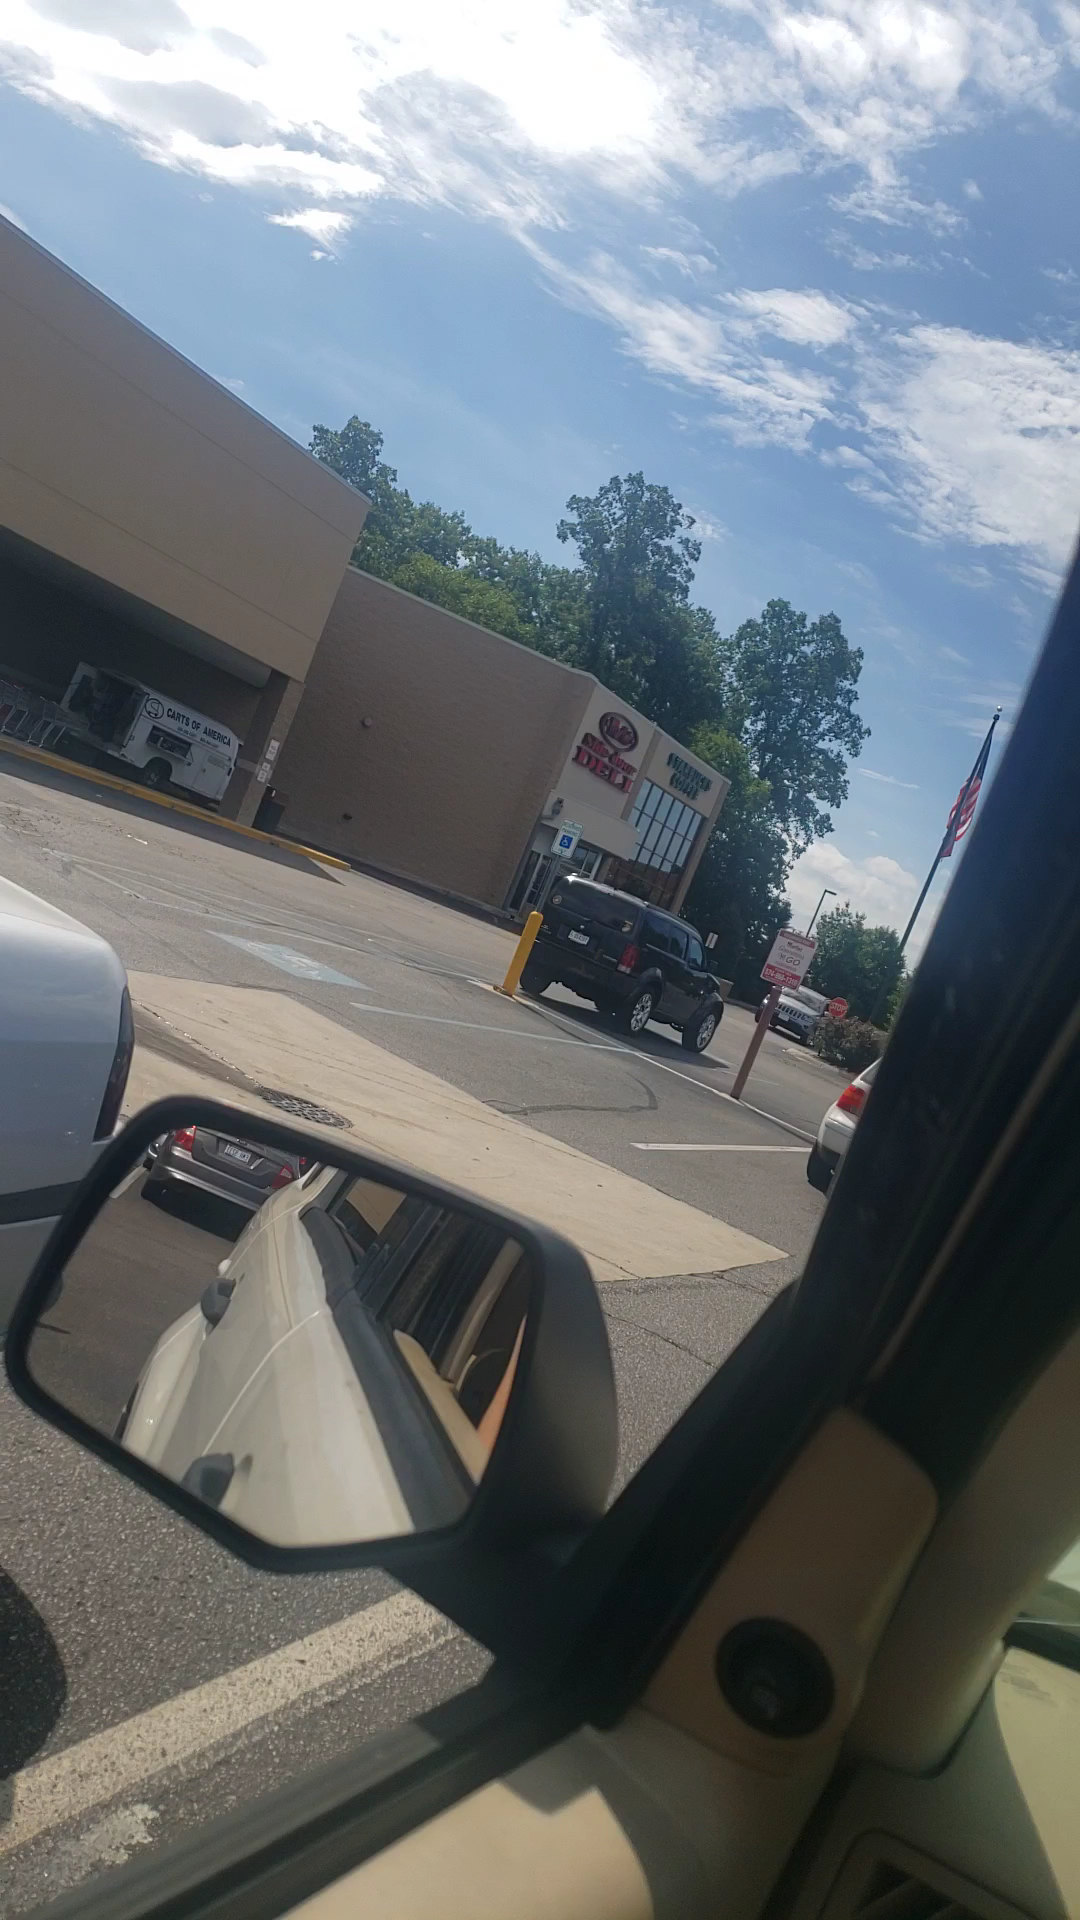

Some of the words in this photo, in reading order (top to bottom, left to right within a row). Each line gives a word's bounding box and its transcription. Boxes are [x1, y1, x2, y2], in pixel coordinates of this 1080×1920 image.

[167, 708, 190, 727] CARTS
[191, 720, 201, 731] OF
[203, 726, 231, 747] AMERICA
[572, 746, 633, 793] DELI
[785, 956, 800, 966] GO
[830, 1002, 848, 1012] STOP
